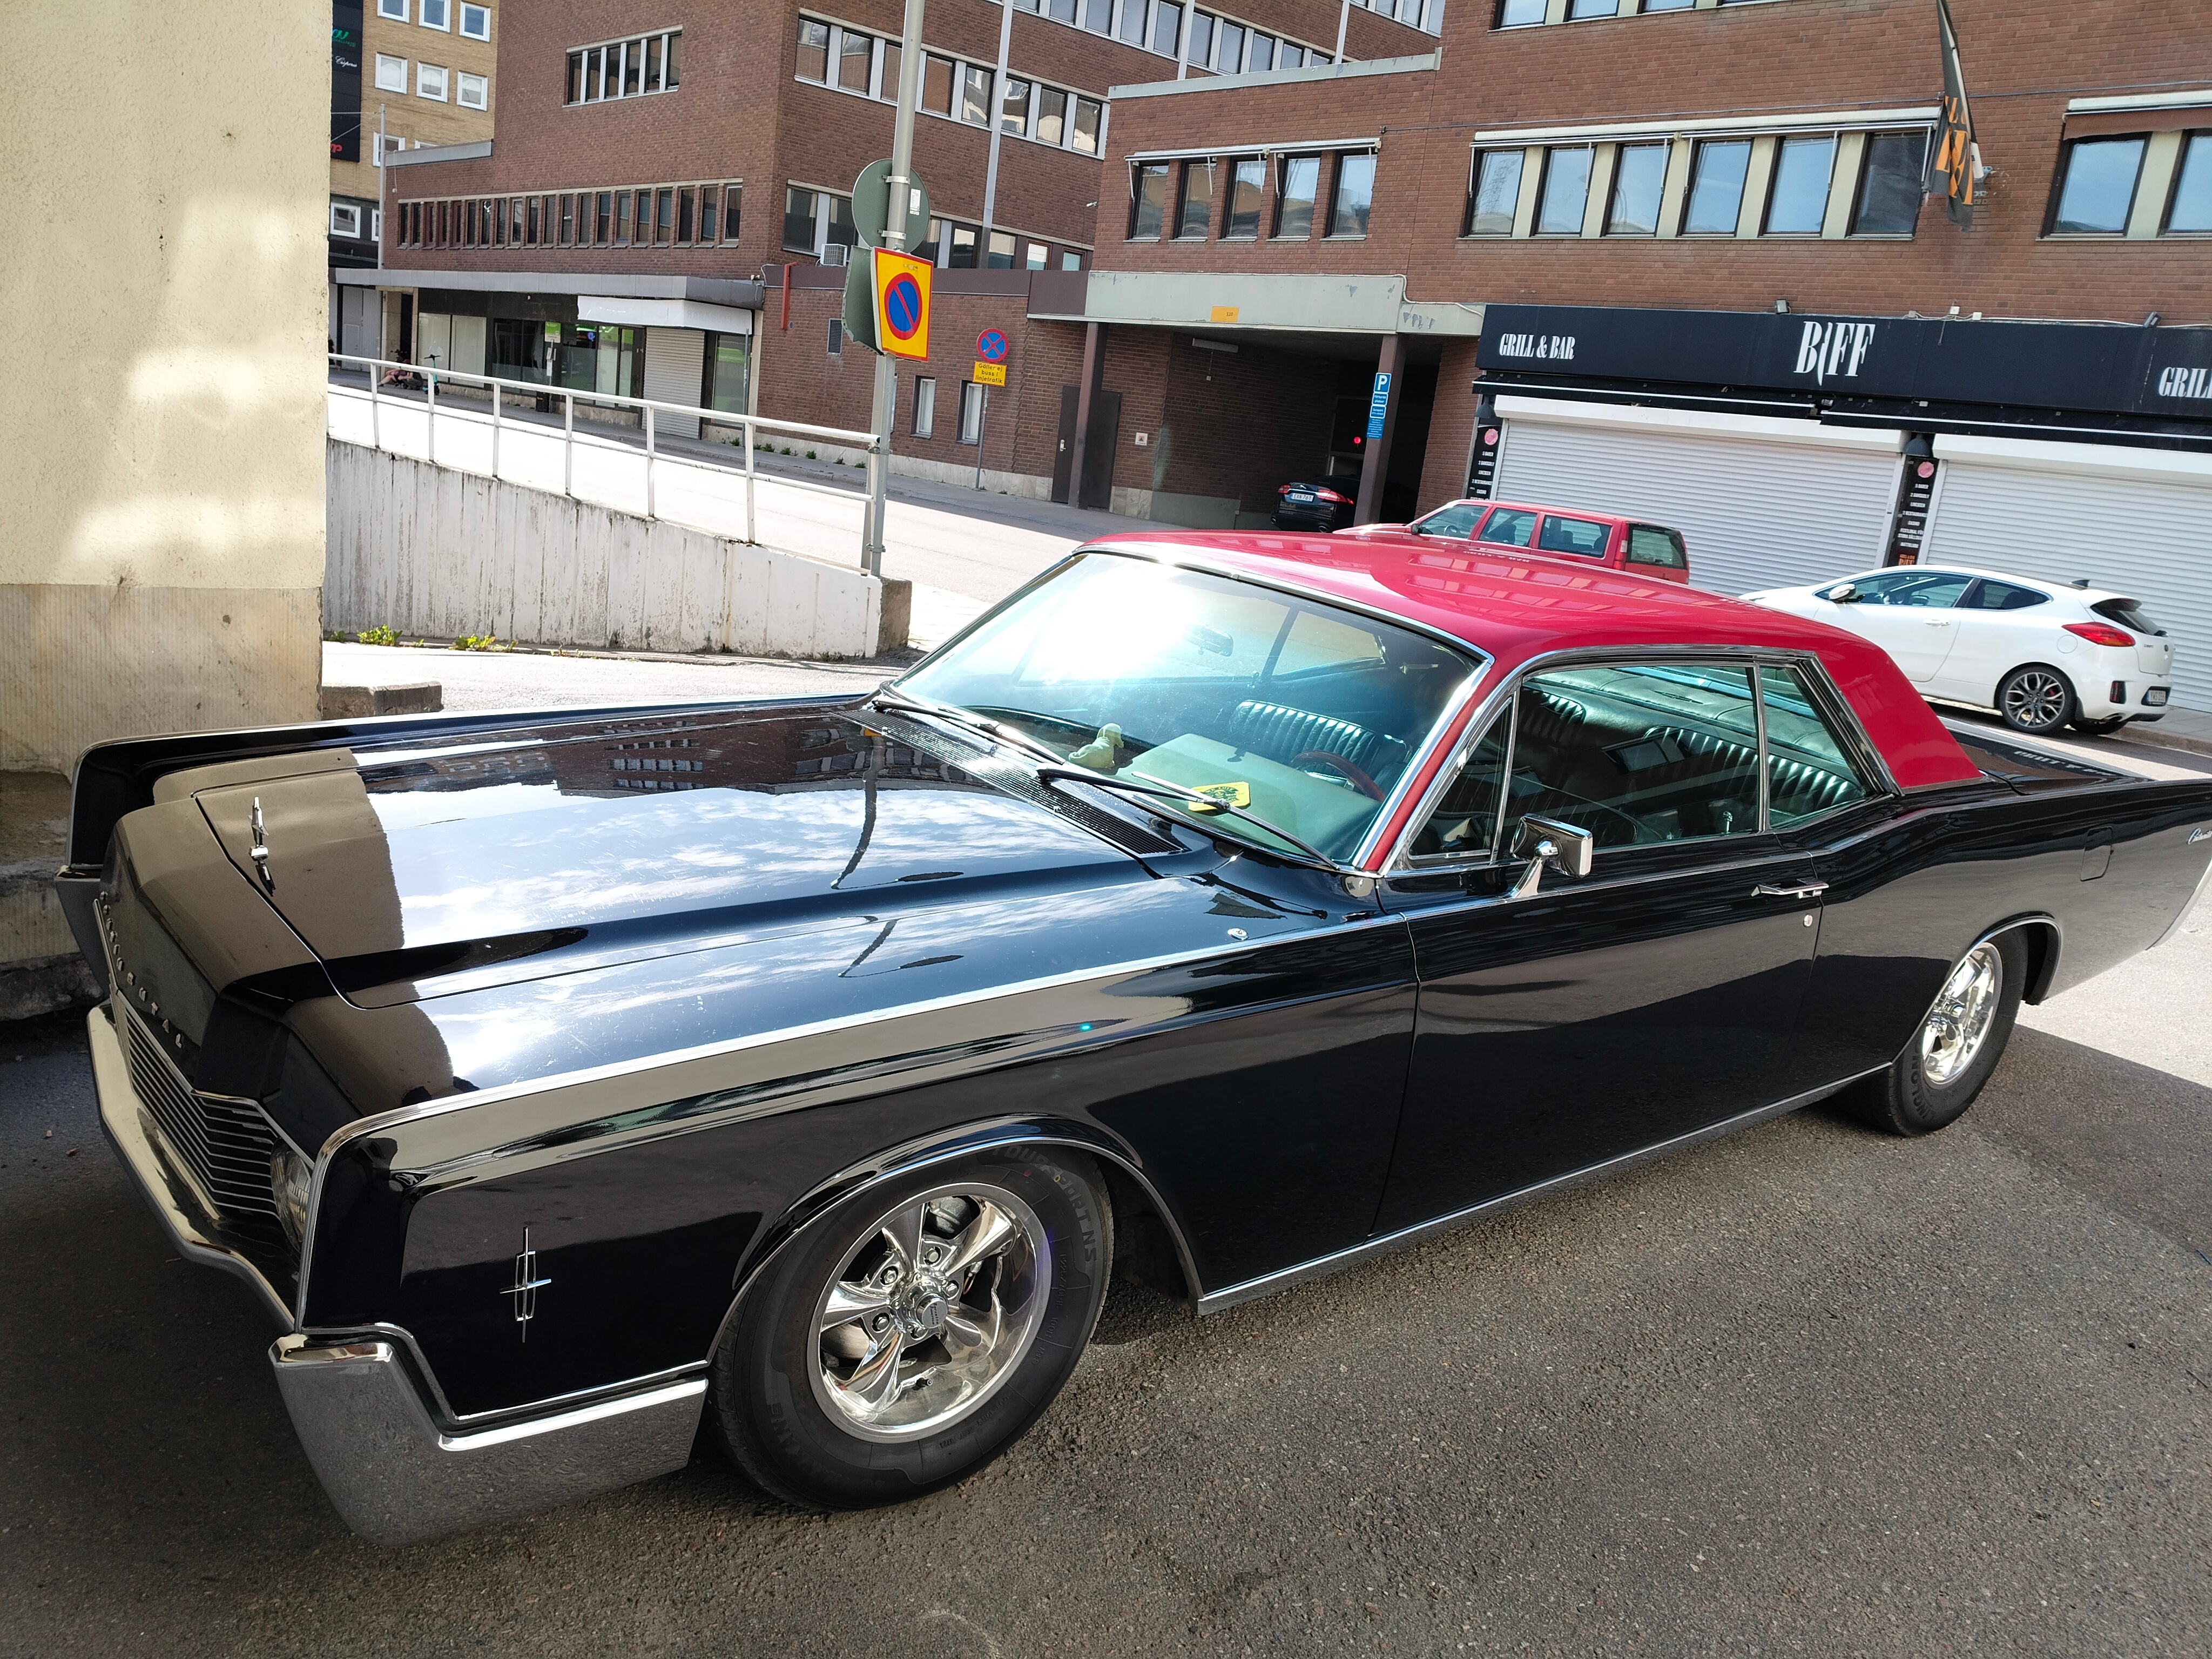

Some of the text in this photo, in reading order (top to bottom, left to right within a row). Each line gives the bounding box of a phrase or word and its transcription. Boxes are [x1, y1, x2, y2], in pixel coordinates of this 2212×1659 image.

[1499, 333, 1575, 360] GRILL & BAR
[1793, 321, 1876, 386] BIFF
[975, 375, 1002, 383] linjetrafik
[1377, 375, 1388, 390] P
